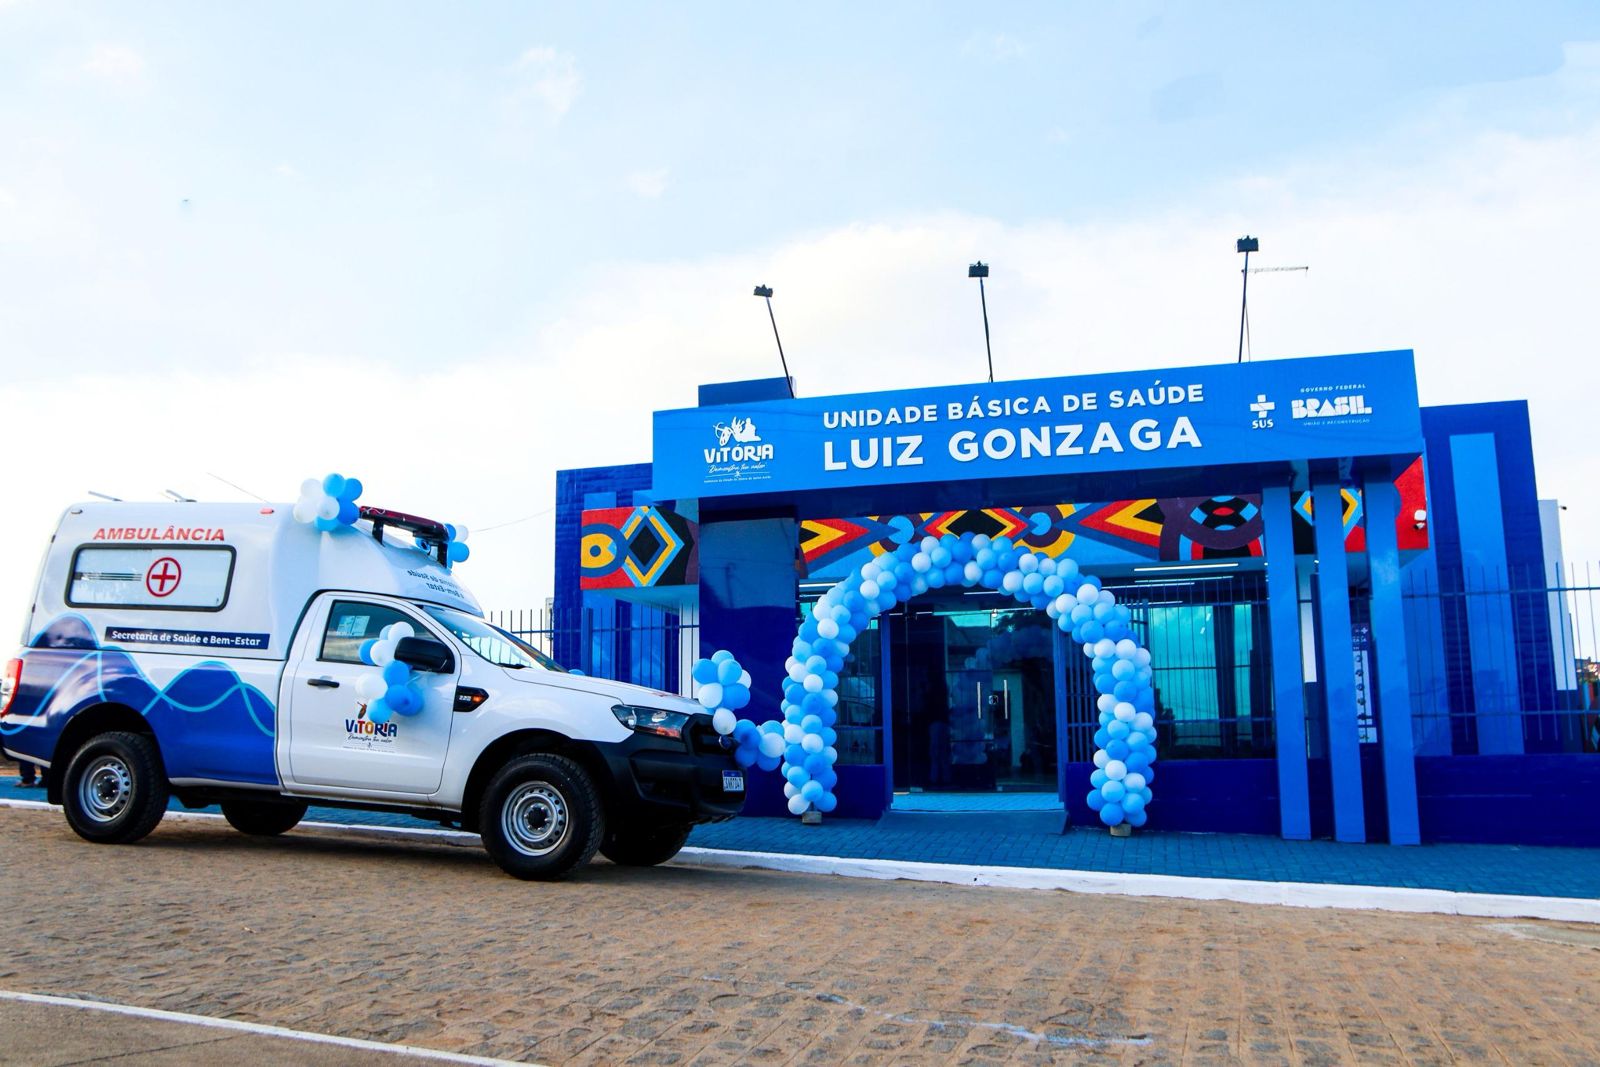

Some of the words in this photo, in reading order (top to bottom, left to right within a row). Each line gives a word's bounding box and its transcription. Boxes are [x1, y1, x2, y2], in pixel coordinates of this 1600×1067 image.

[1300, 386, 1334, 394] GOVERNO
[1335, 383, 1367, 391] FEDERAL
[823, 404, 938, 429] UNIDADE
[947, 395, 1051, 421] BÁSICA
[1062, 392, 1098, 413] DE
[1109, 380, 1204, 409] SAÚDE
[1291, 395, 1373, 419] BRASIL
[1252, 418, 1274, 430] SUS
[824, 434, 924, 471] LUIZ
[948, 416, 1203, 462] GONZAGA
[93, 525, 225, 541] AMBULÂNCIA
[112, 630, 159, 642] Secretaria
[159, 632, 171, 643] de
[173, 633, 201, 644] Saúde
[202, 636, 208, 645] e
[210, 635, 261, 647] Bem-Estar
